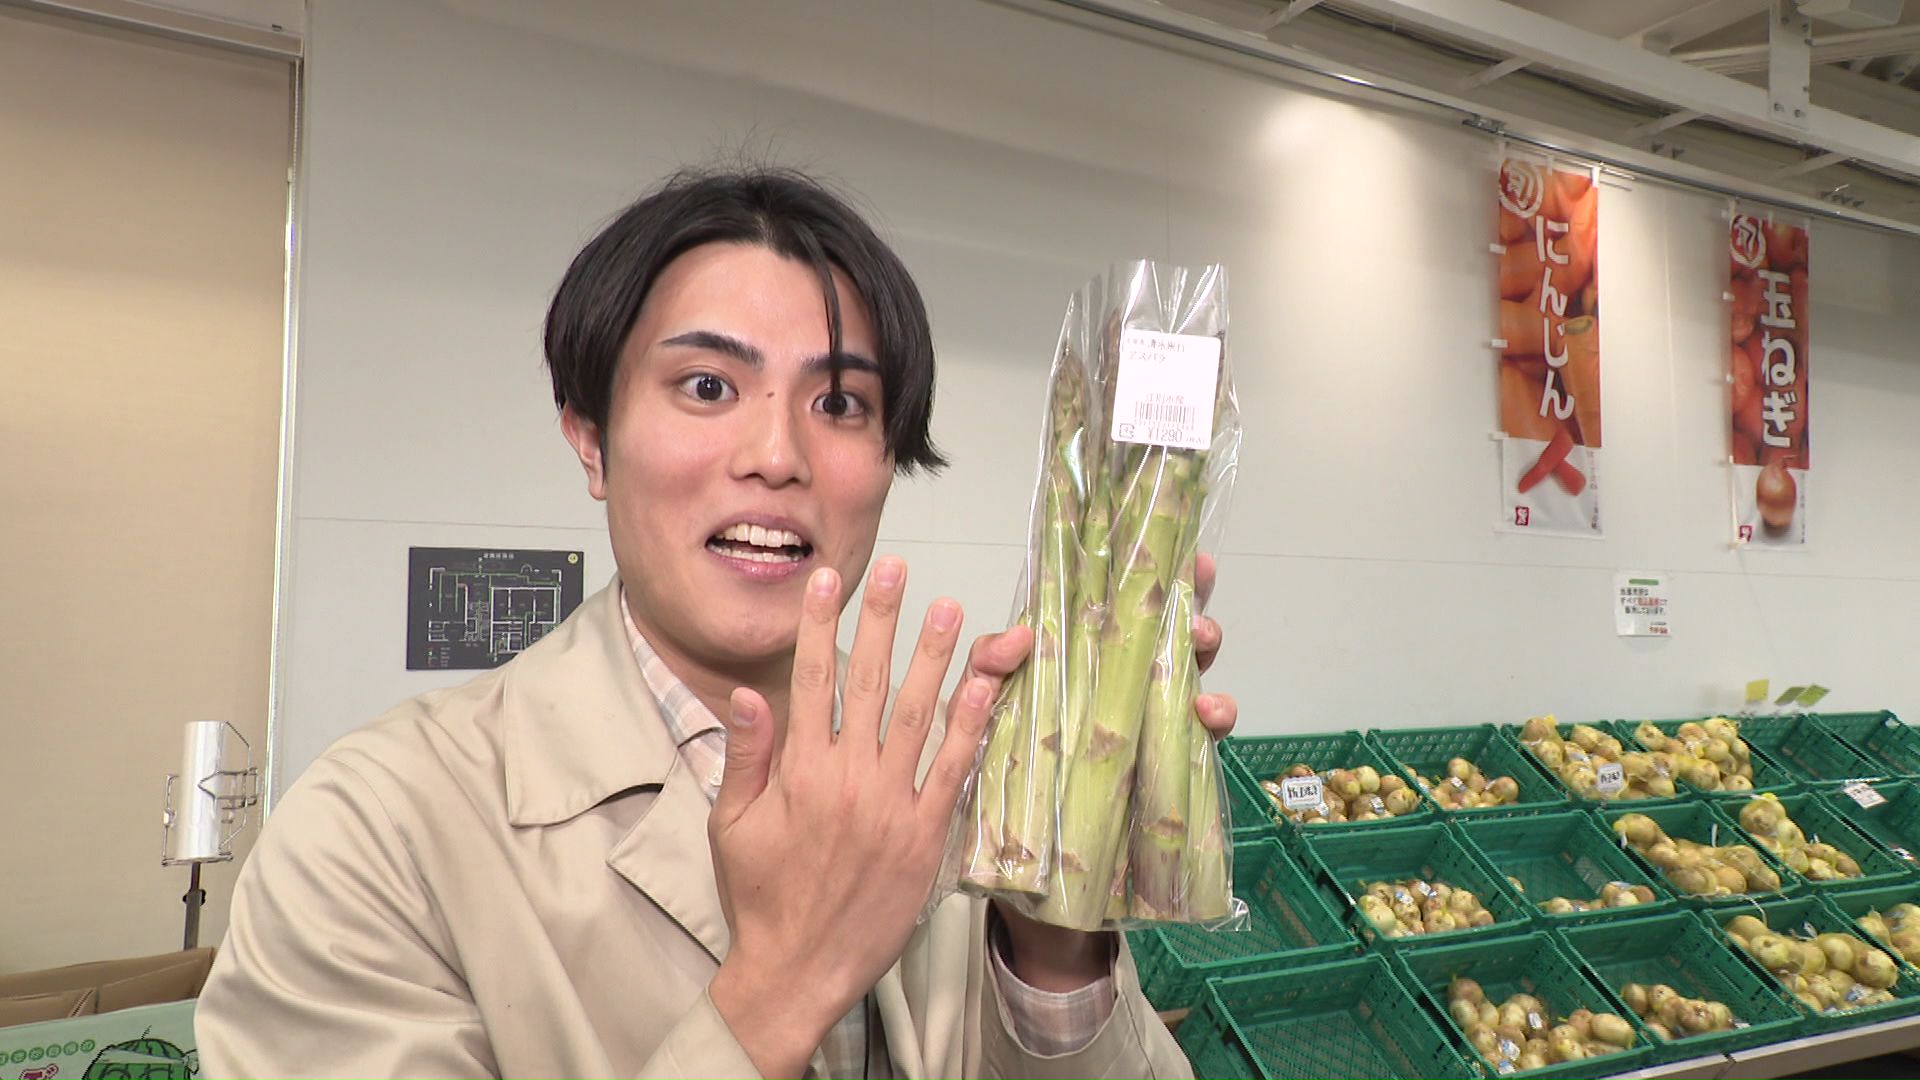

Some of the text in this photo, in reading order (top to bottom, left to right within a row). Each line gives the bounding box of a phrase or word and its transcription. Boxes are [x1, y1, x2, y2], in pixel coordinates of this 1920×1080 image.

[1129, 351, 1166, 363] アスパラ
[1536, 215, 1575, 420] にんじん
[1758, 269, 1796, 448] 玉ねぎ
[1147, 427, 1183, 443] ¥1290
